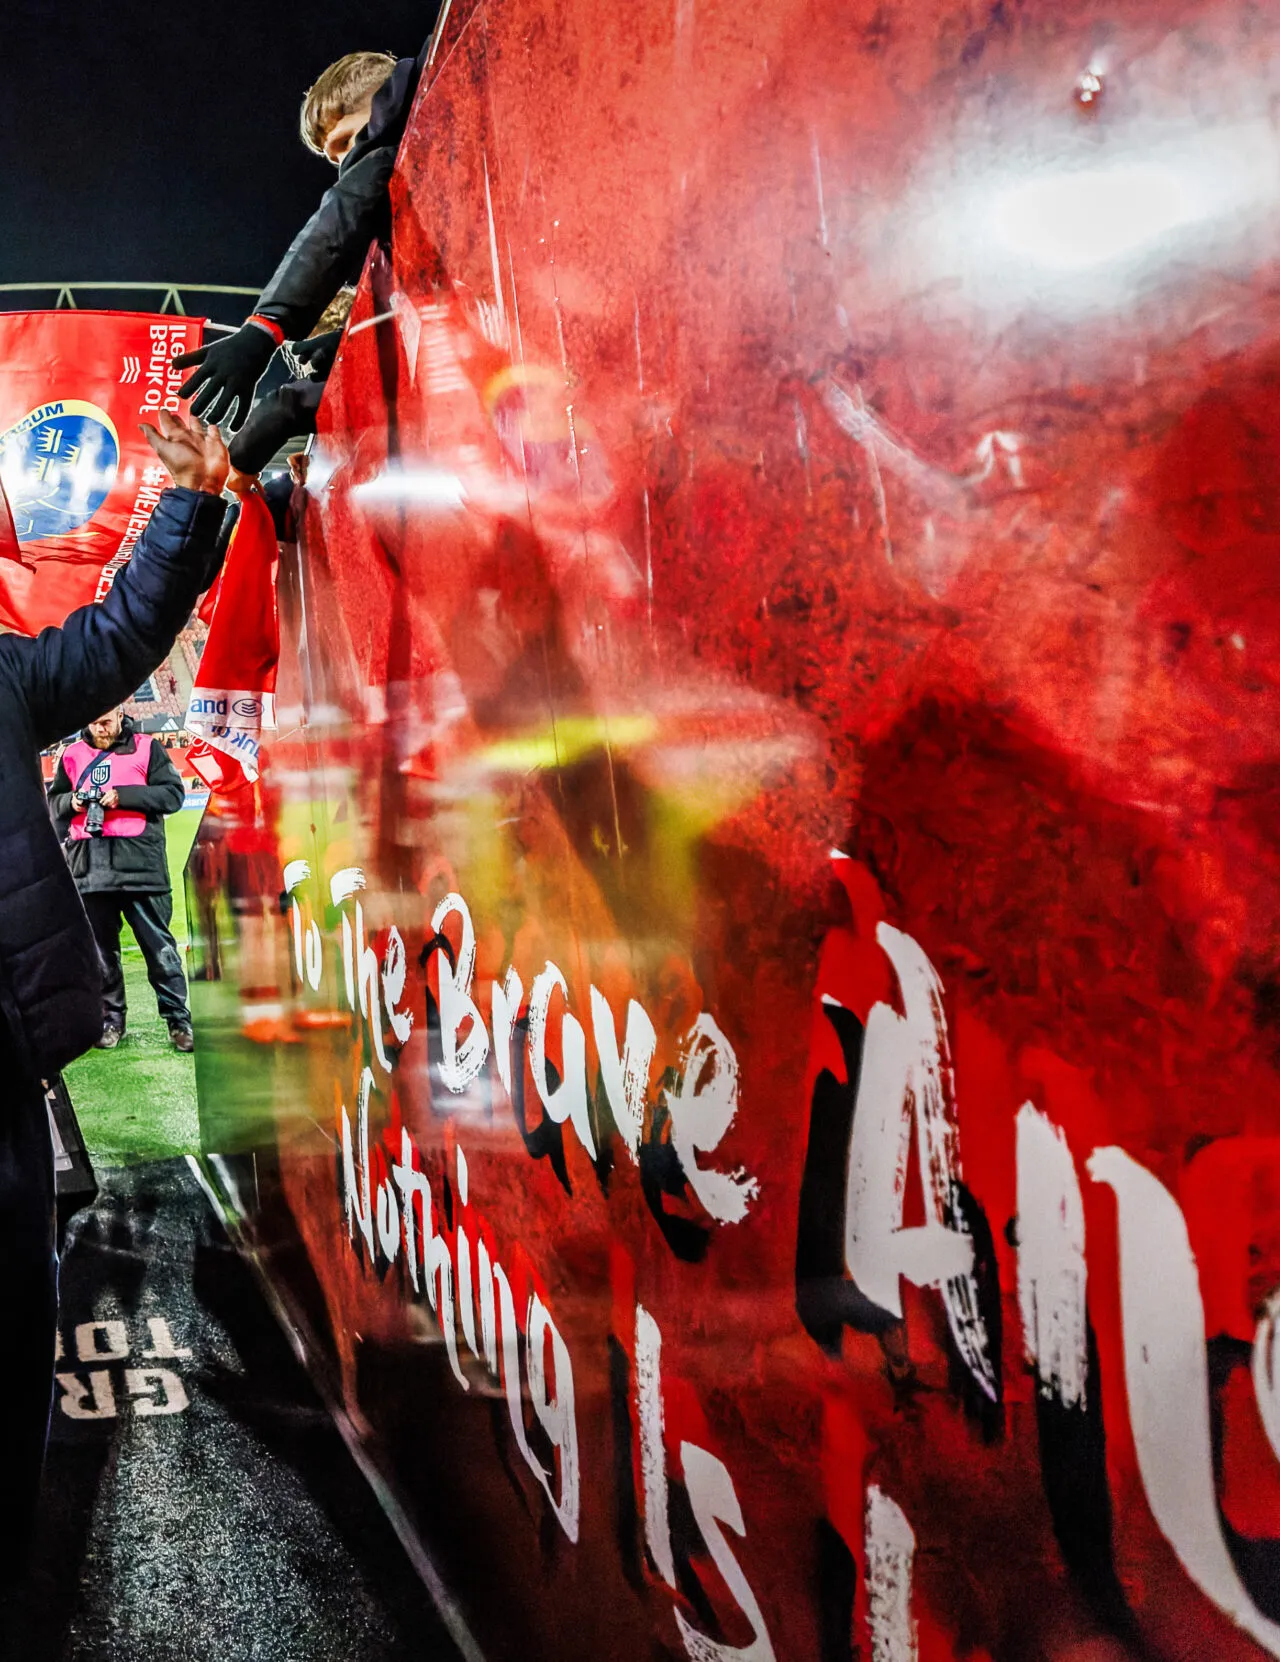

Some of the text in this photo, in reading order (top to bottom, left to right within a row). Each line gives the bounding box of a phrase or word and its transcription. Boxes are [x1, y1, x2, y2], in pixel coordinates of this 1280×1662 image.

[284, 860, 1280, 1656] To The Brave An
[341, 1066, 580, 1545] Nothing
[633, 1302, 778, 1662] Is
